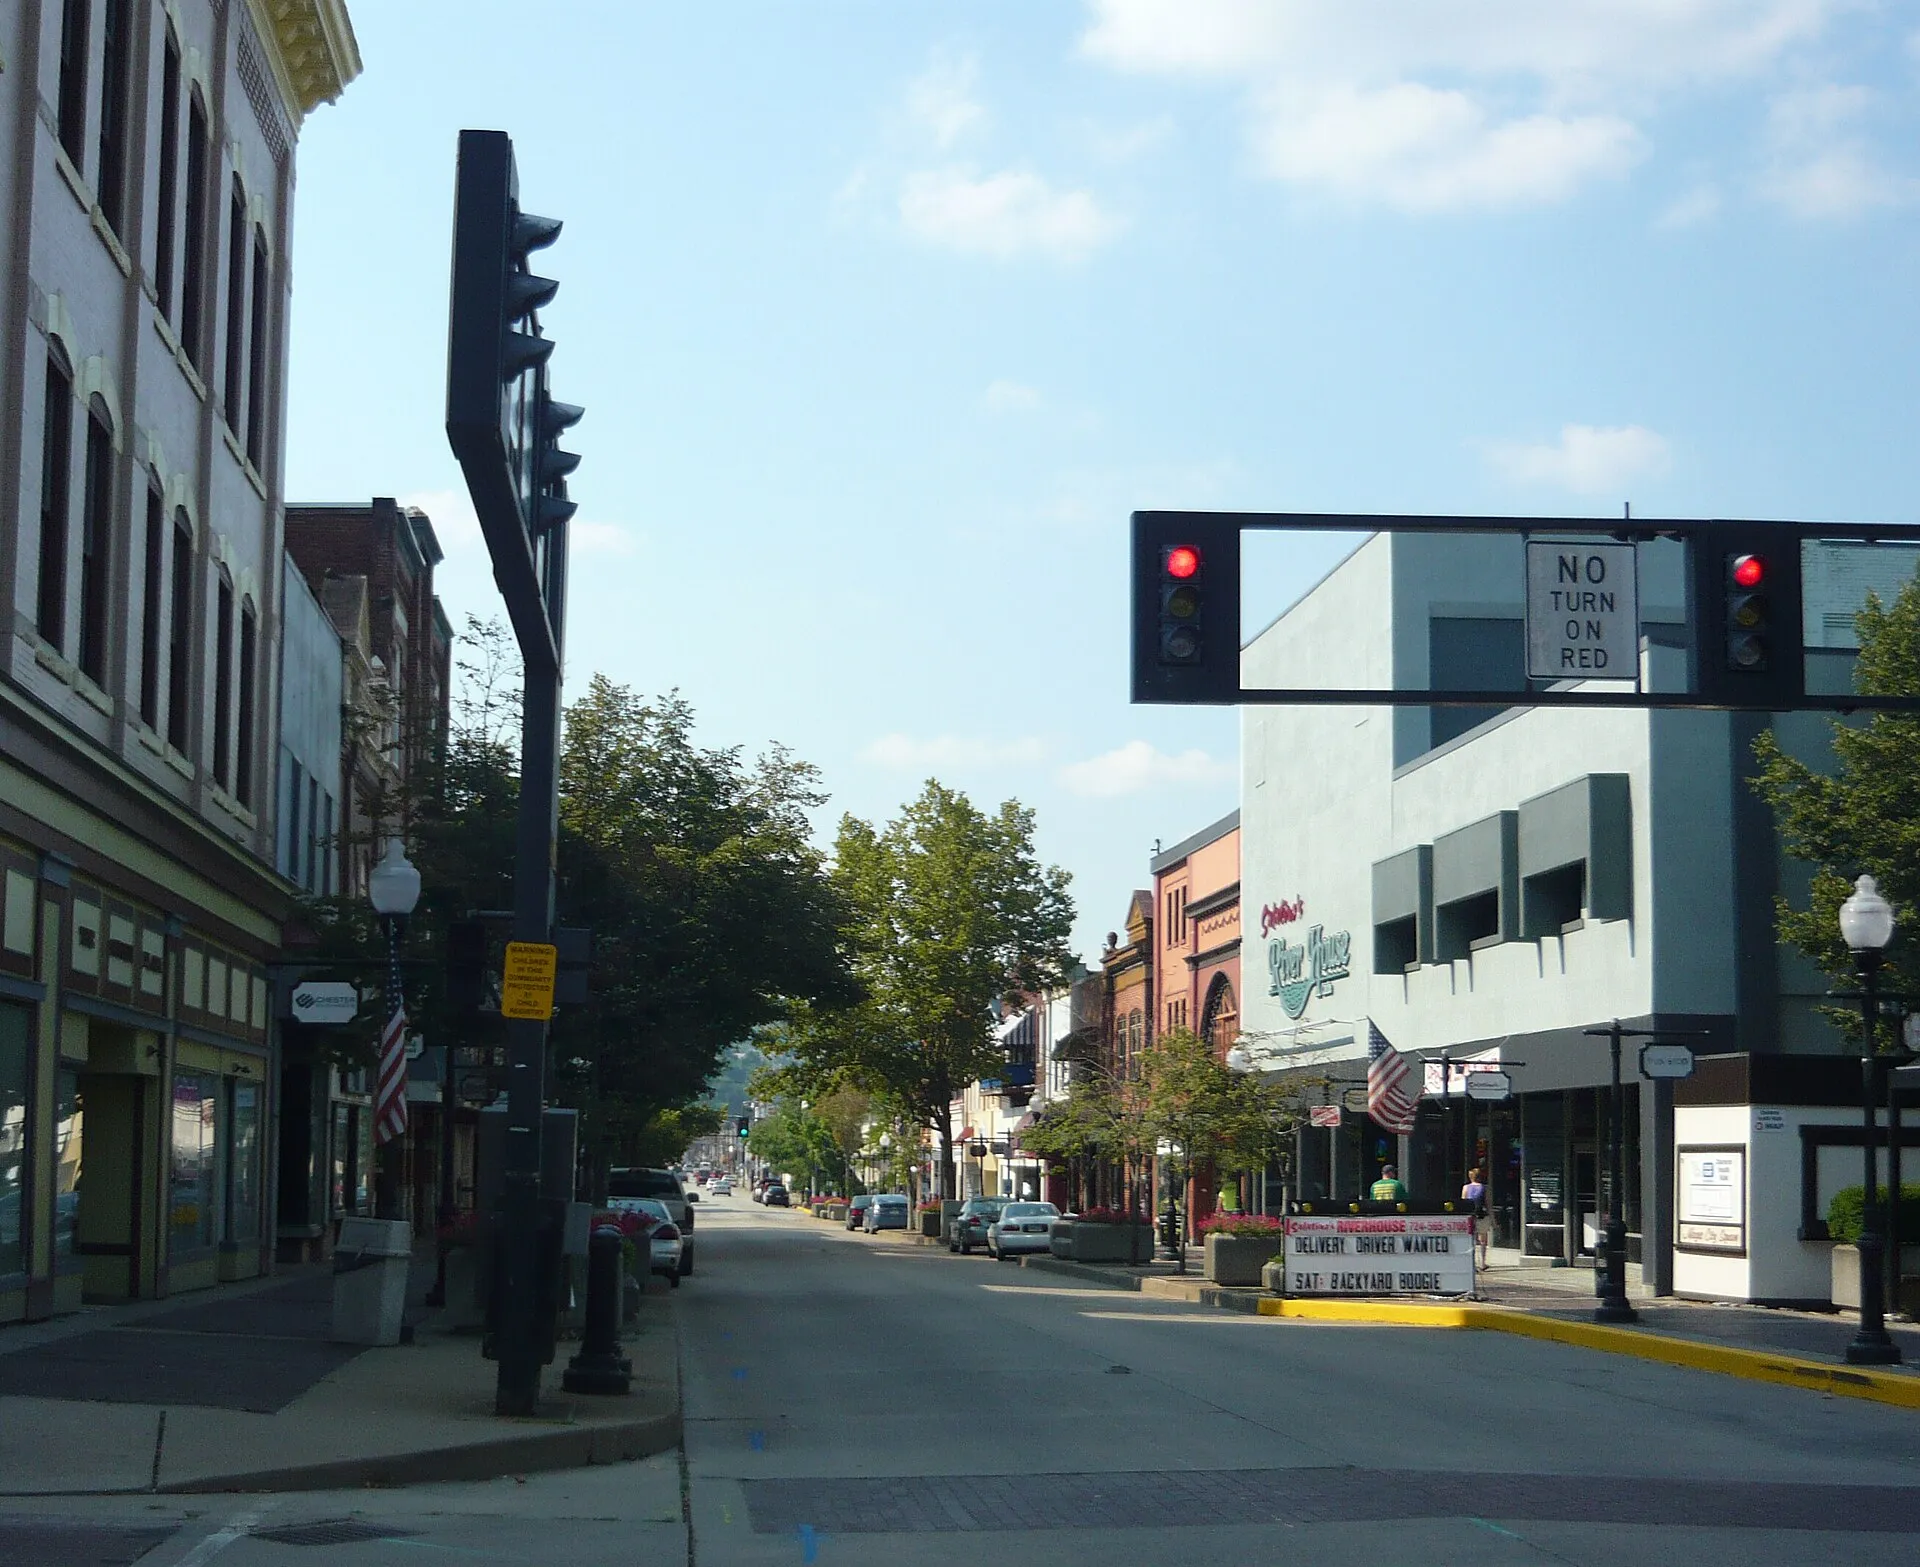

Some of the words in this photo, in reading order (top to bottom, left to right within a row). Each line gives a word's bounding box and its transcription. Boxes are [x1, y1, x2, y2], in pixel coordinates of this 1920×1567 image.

[1558, 555, 1605, 584] NO
[1550, 591, 1614, 612] TURN
[1565, 620, 1601, 640] ON
[1561, 648, 1608, 669] RED
[1268, 938, 1305, 990] River
[1308, 923, 1351, 984] House
[508, 974, 551, 982] COMMUNITY
[507, 983, 551, 991] PROTECTED
[509, 1007, 544, 1015] REGISTRY
[1337, 1220, 1407, 1233] RIVERHOUSE
[1295, 1236, 1345, 1253] DELIVERY
[1355, 1236, 1396, 1253] DRIVER
[1402, 1236, 1449, 1253] WANTED
[1295, 1273, 1324, 1290] SAT:
[1331, 1273, 1392, 1290] BACKYARD
[1400, 1273, 1441, 1290] BOOGIE
